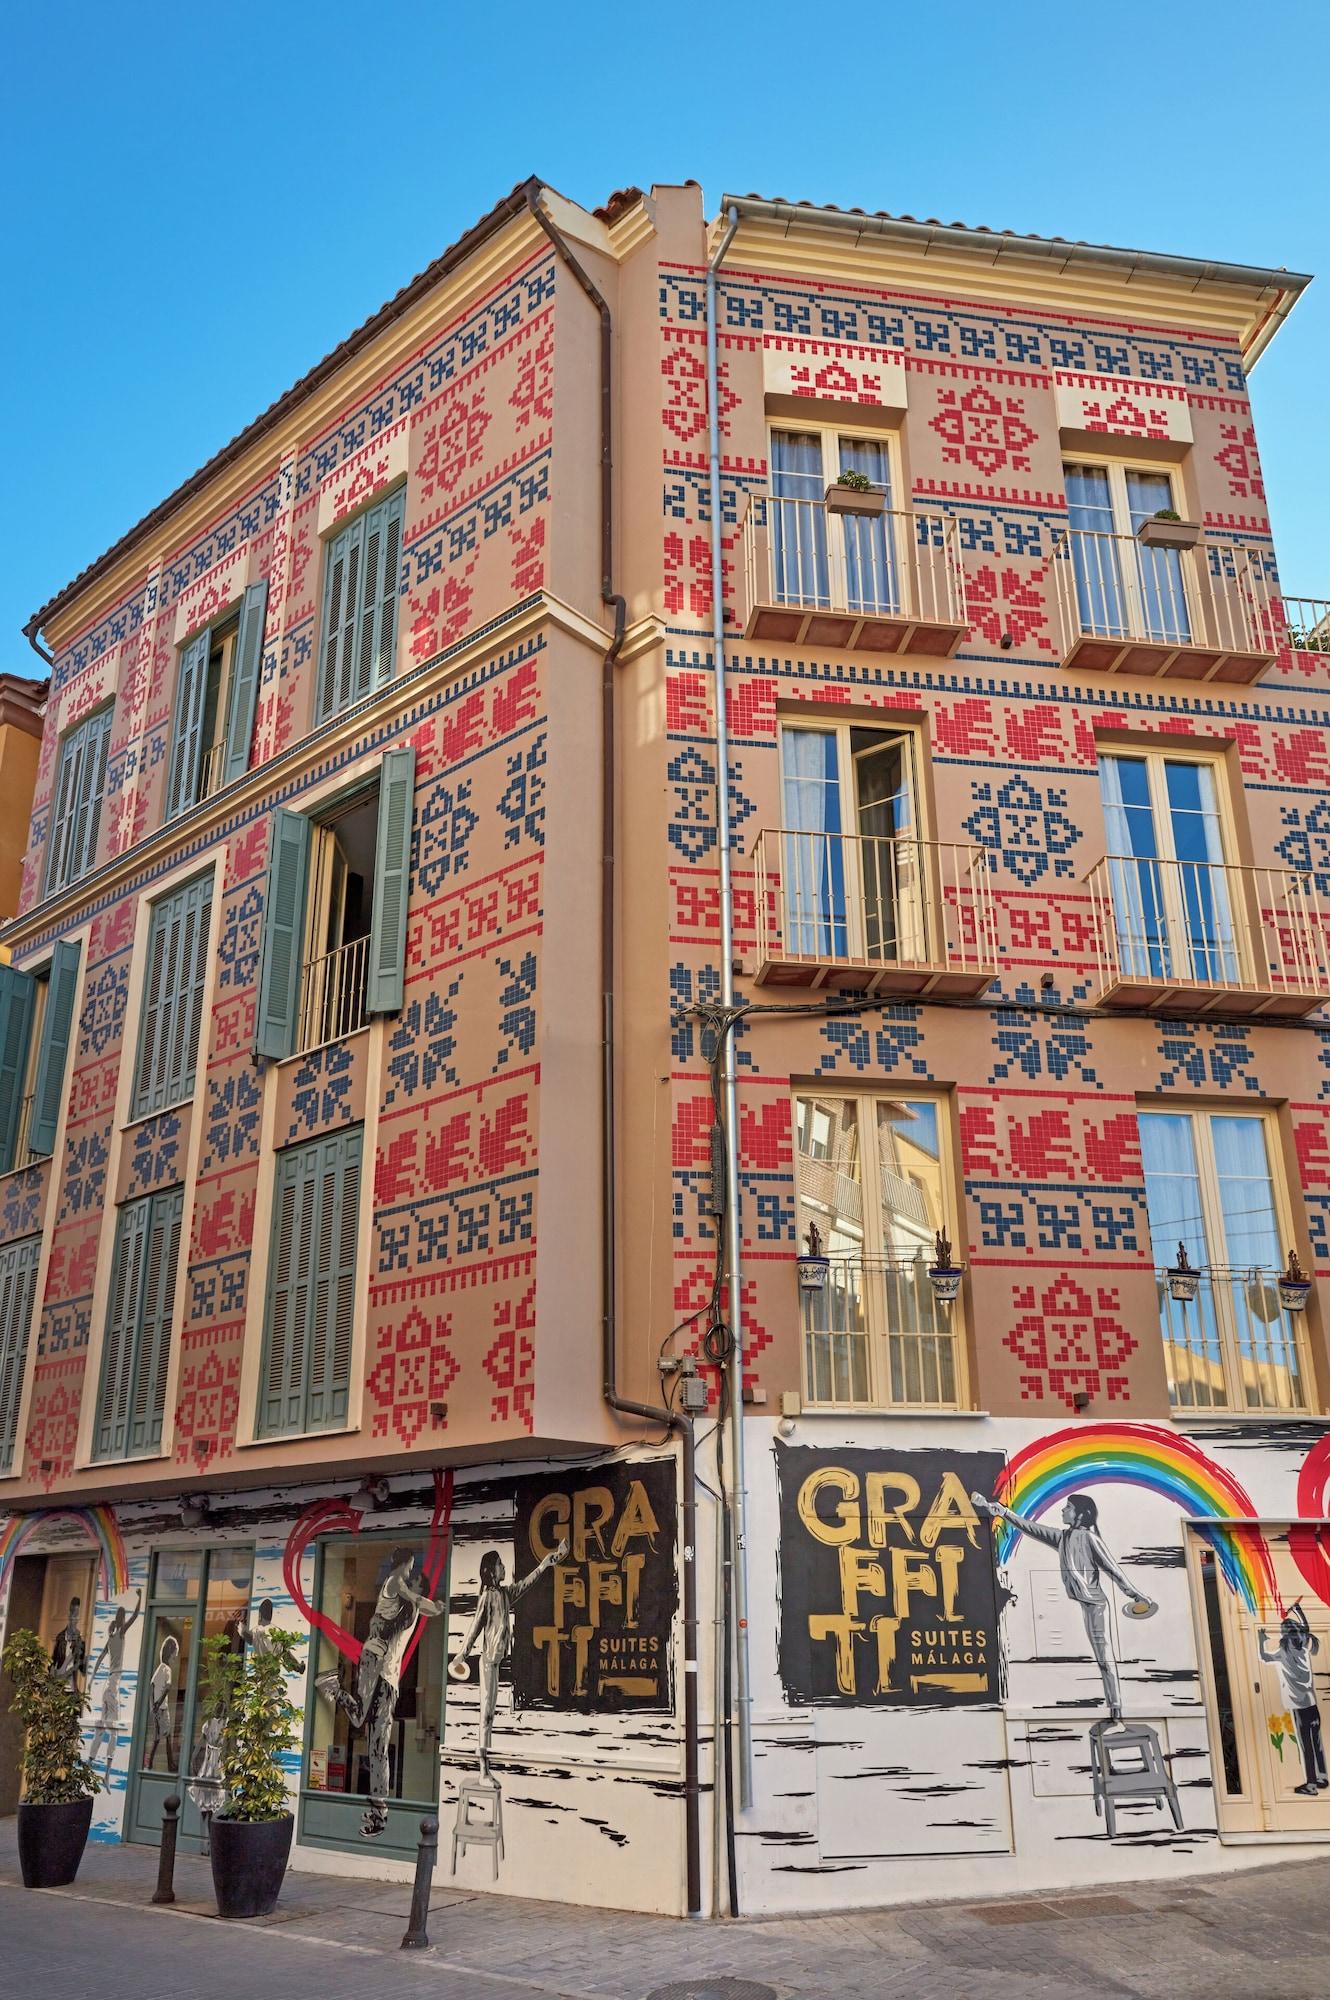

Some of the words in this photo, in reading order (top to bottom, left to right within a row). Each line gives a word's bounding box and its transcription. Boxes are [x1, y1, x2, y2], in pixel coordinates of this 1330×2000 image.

[528, 1480, 660, 1562] GRA
[797, 1466, 982, 1549] GRA
[553, 1553, 645, 1629] FFI
[838, 1545, 965, 1622] FFI
[599, 1636, 659, 1653] SUITES
[911, 1630, 987, 1647] SUITES
[911, 1649, 987, 1665] MÁLAGA
[599, 1655, 658, 1670] MÁLAGA
